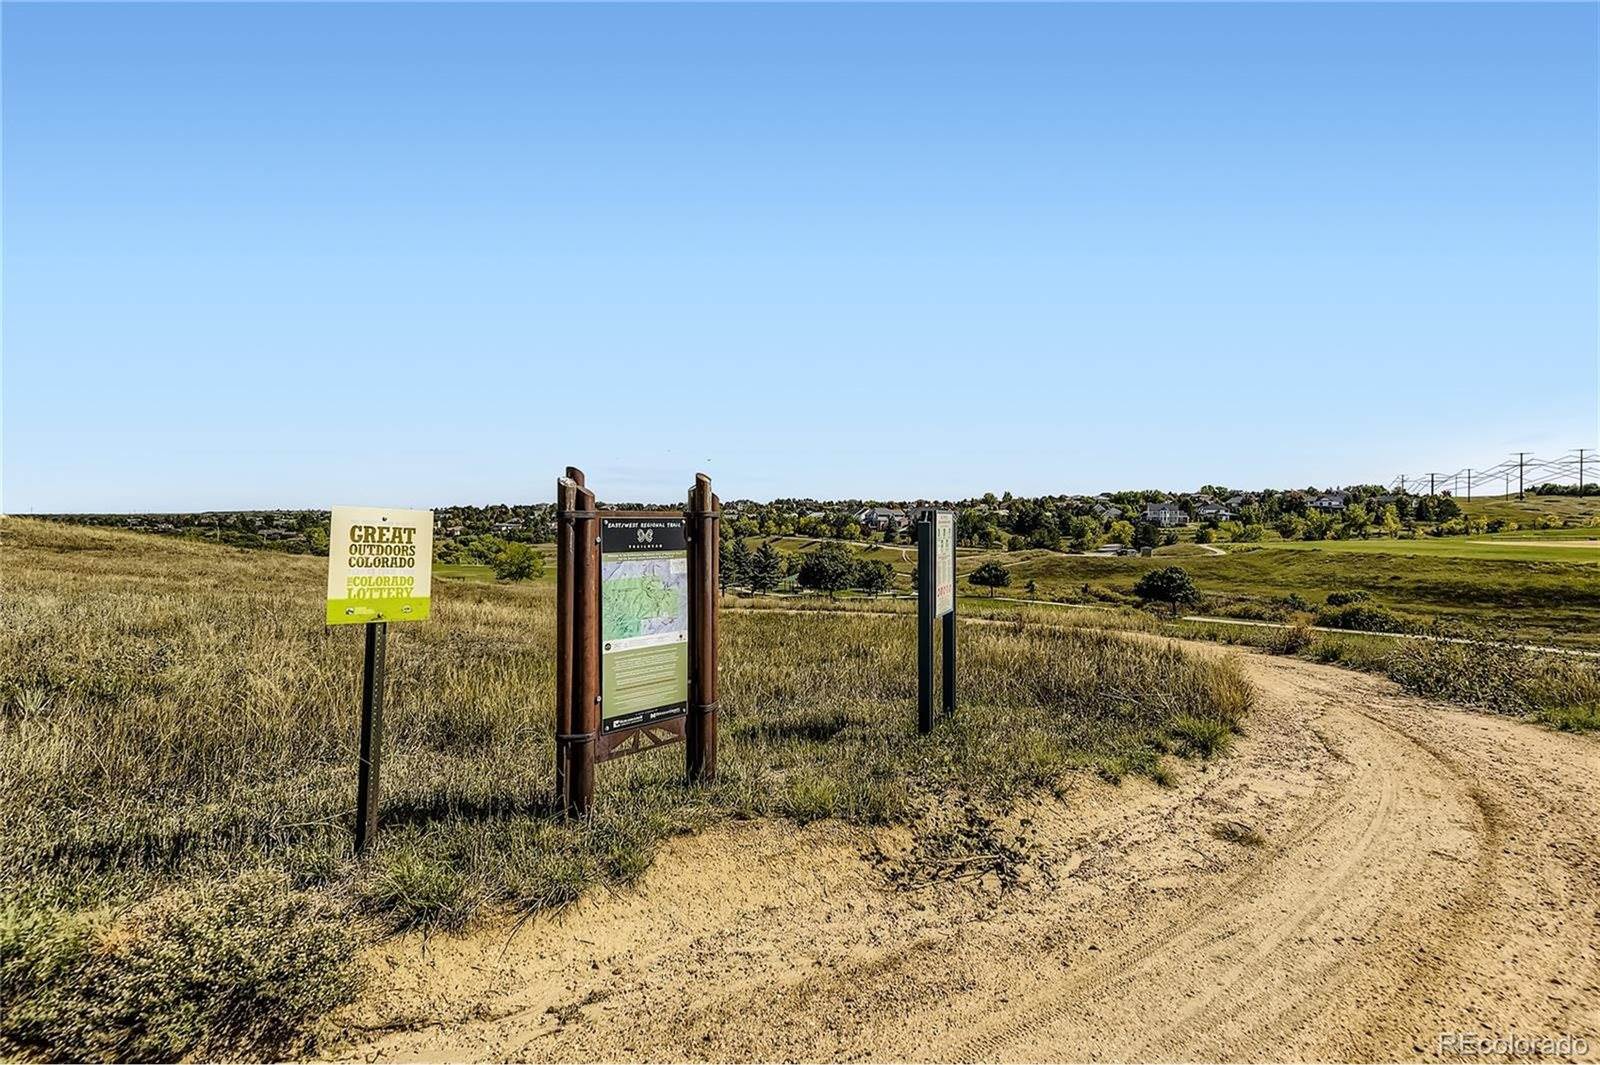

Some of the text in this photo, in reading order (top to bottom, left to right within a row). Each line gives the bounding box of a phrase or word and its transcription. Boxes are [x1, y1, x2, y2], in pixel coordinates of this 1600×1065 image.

[350, 525, 416, 544] GREAT
[349, 544, 416, 556] OUTDOORS
[348, 557, 415, 568] COLORADO
[353, 576, 414, 587] COLORADO
[347, 587, 413, 600] LOTTERY
